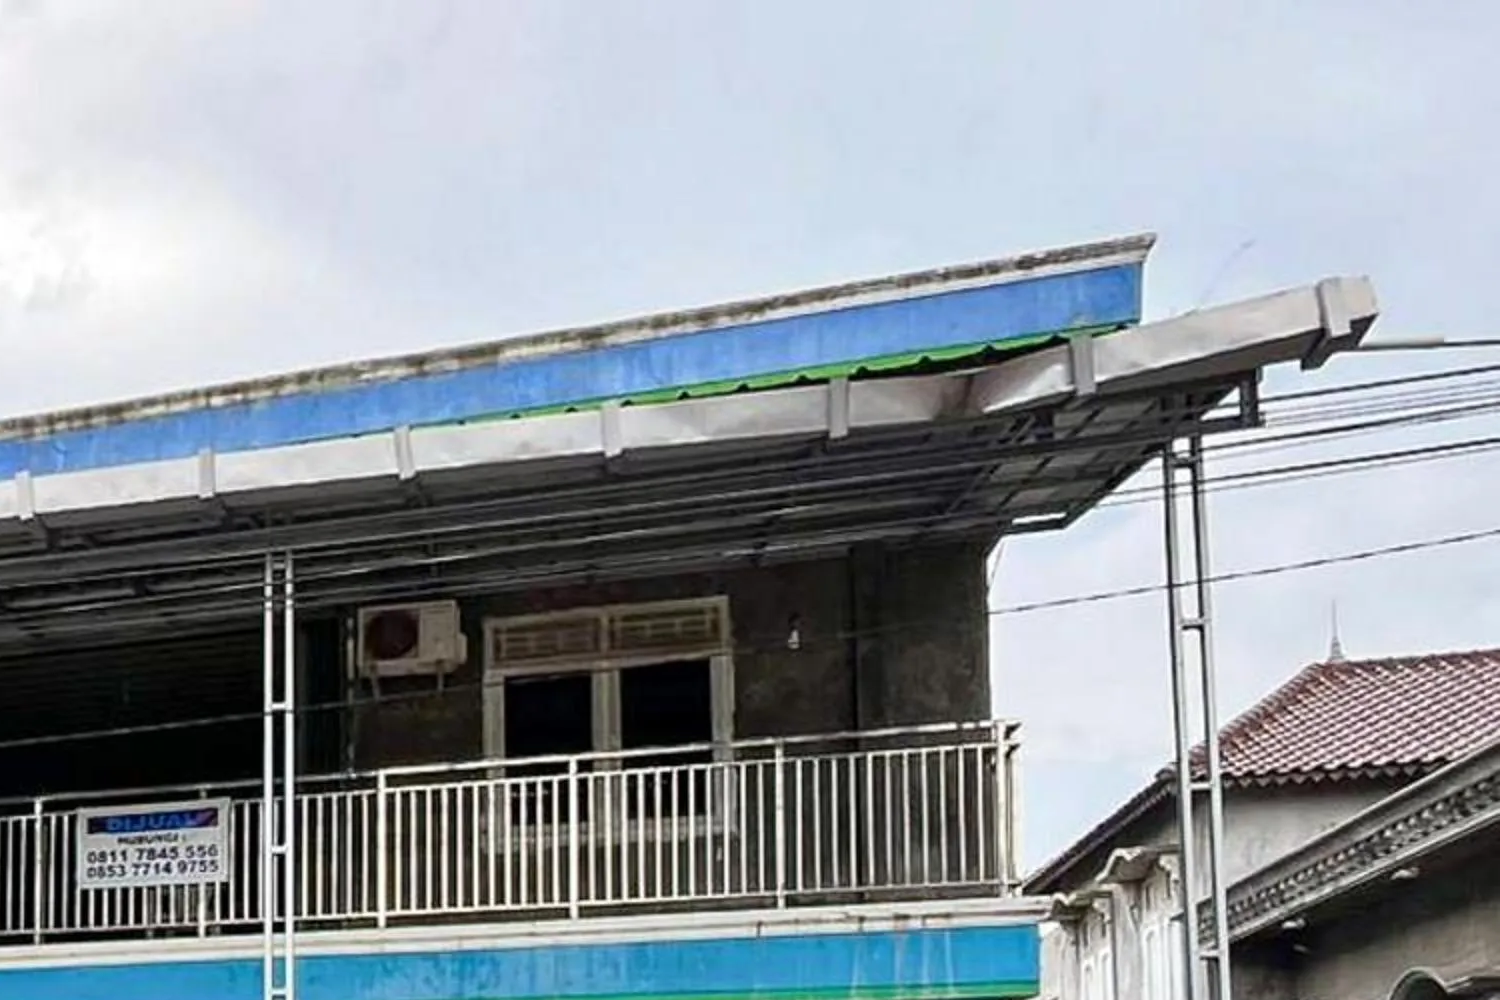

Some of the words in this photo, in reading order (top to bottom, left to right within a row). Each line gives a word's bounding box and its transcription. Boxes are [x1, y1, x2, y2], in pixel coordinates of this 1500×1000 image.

[106, 813, 199, 831] DIJUAL
[86, 850, 127, 864] 0811
[136, 846, 179, 861] 7845
[86, 864, 126, 879] 0853
[131, 862, 173, 877] 7714
[177, 860, 219, 874] 9755
